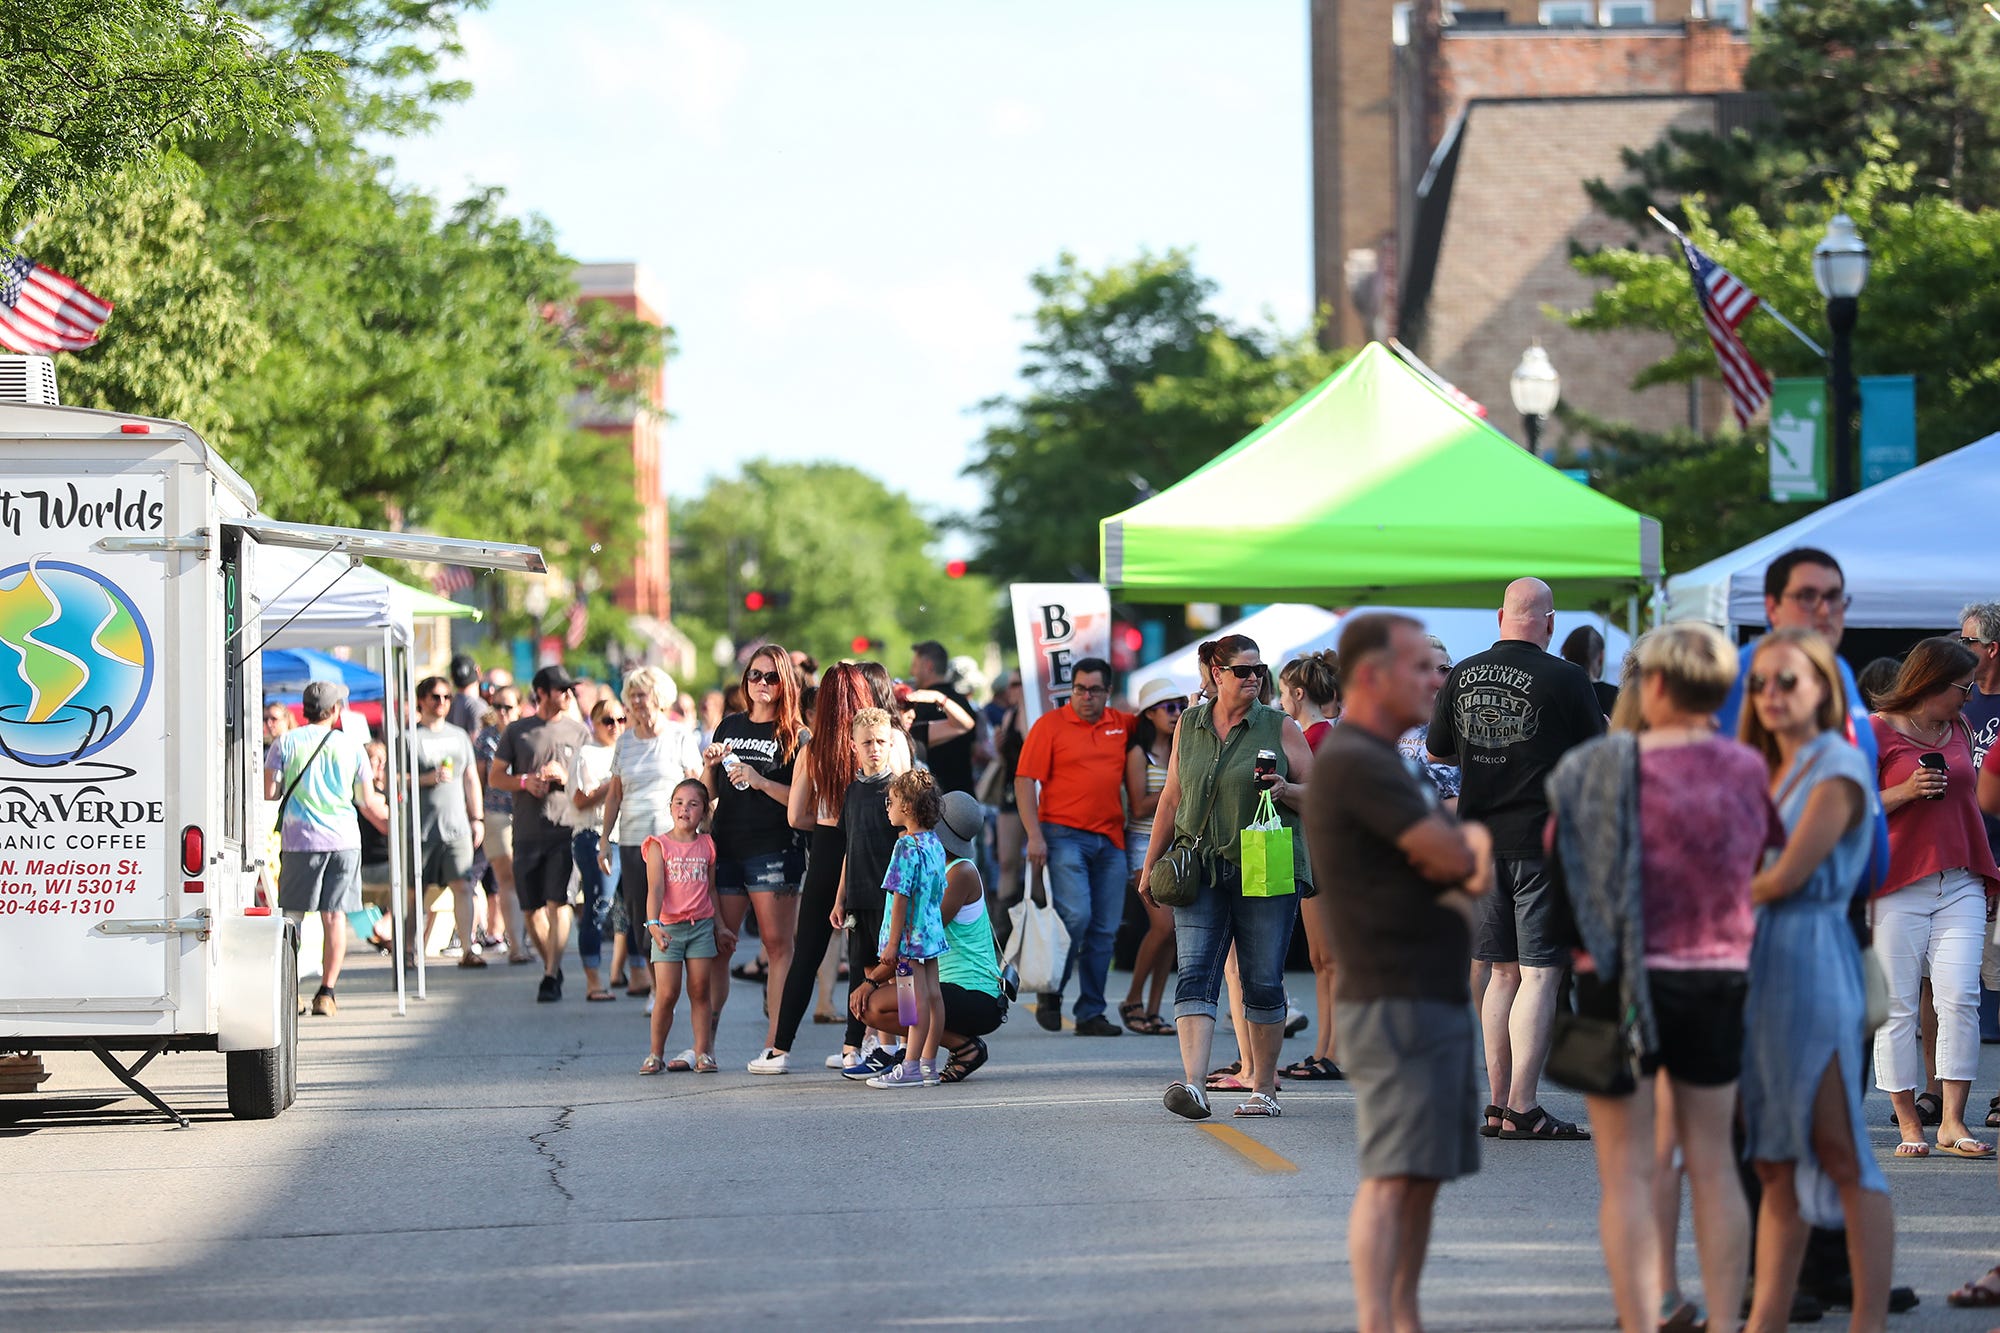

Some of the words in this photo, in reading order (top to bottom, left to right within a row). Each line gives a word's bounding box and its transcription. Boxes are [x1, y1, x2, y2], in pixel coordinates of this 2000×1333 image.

[20, 482, 163, 531] Worlds
[1040, 604, 1072, 709] BE
[1459, 669, 1532, 695] COZUMEL
[1467, 723, 1519, 738] AVIDSON
[723, 737, 778, 762] THRASHER
[0, 835, 55, 850] ANIC
[66, 835, 147, 849] COFFEE
[0, 860, 18, 875] N.
[25, 860, 111, 875] Madison
[117, 859, 143, 875] St.
[45, 879, 72, 894] WI
[77, 879, 136, 894] 53014
